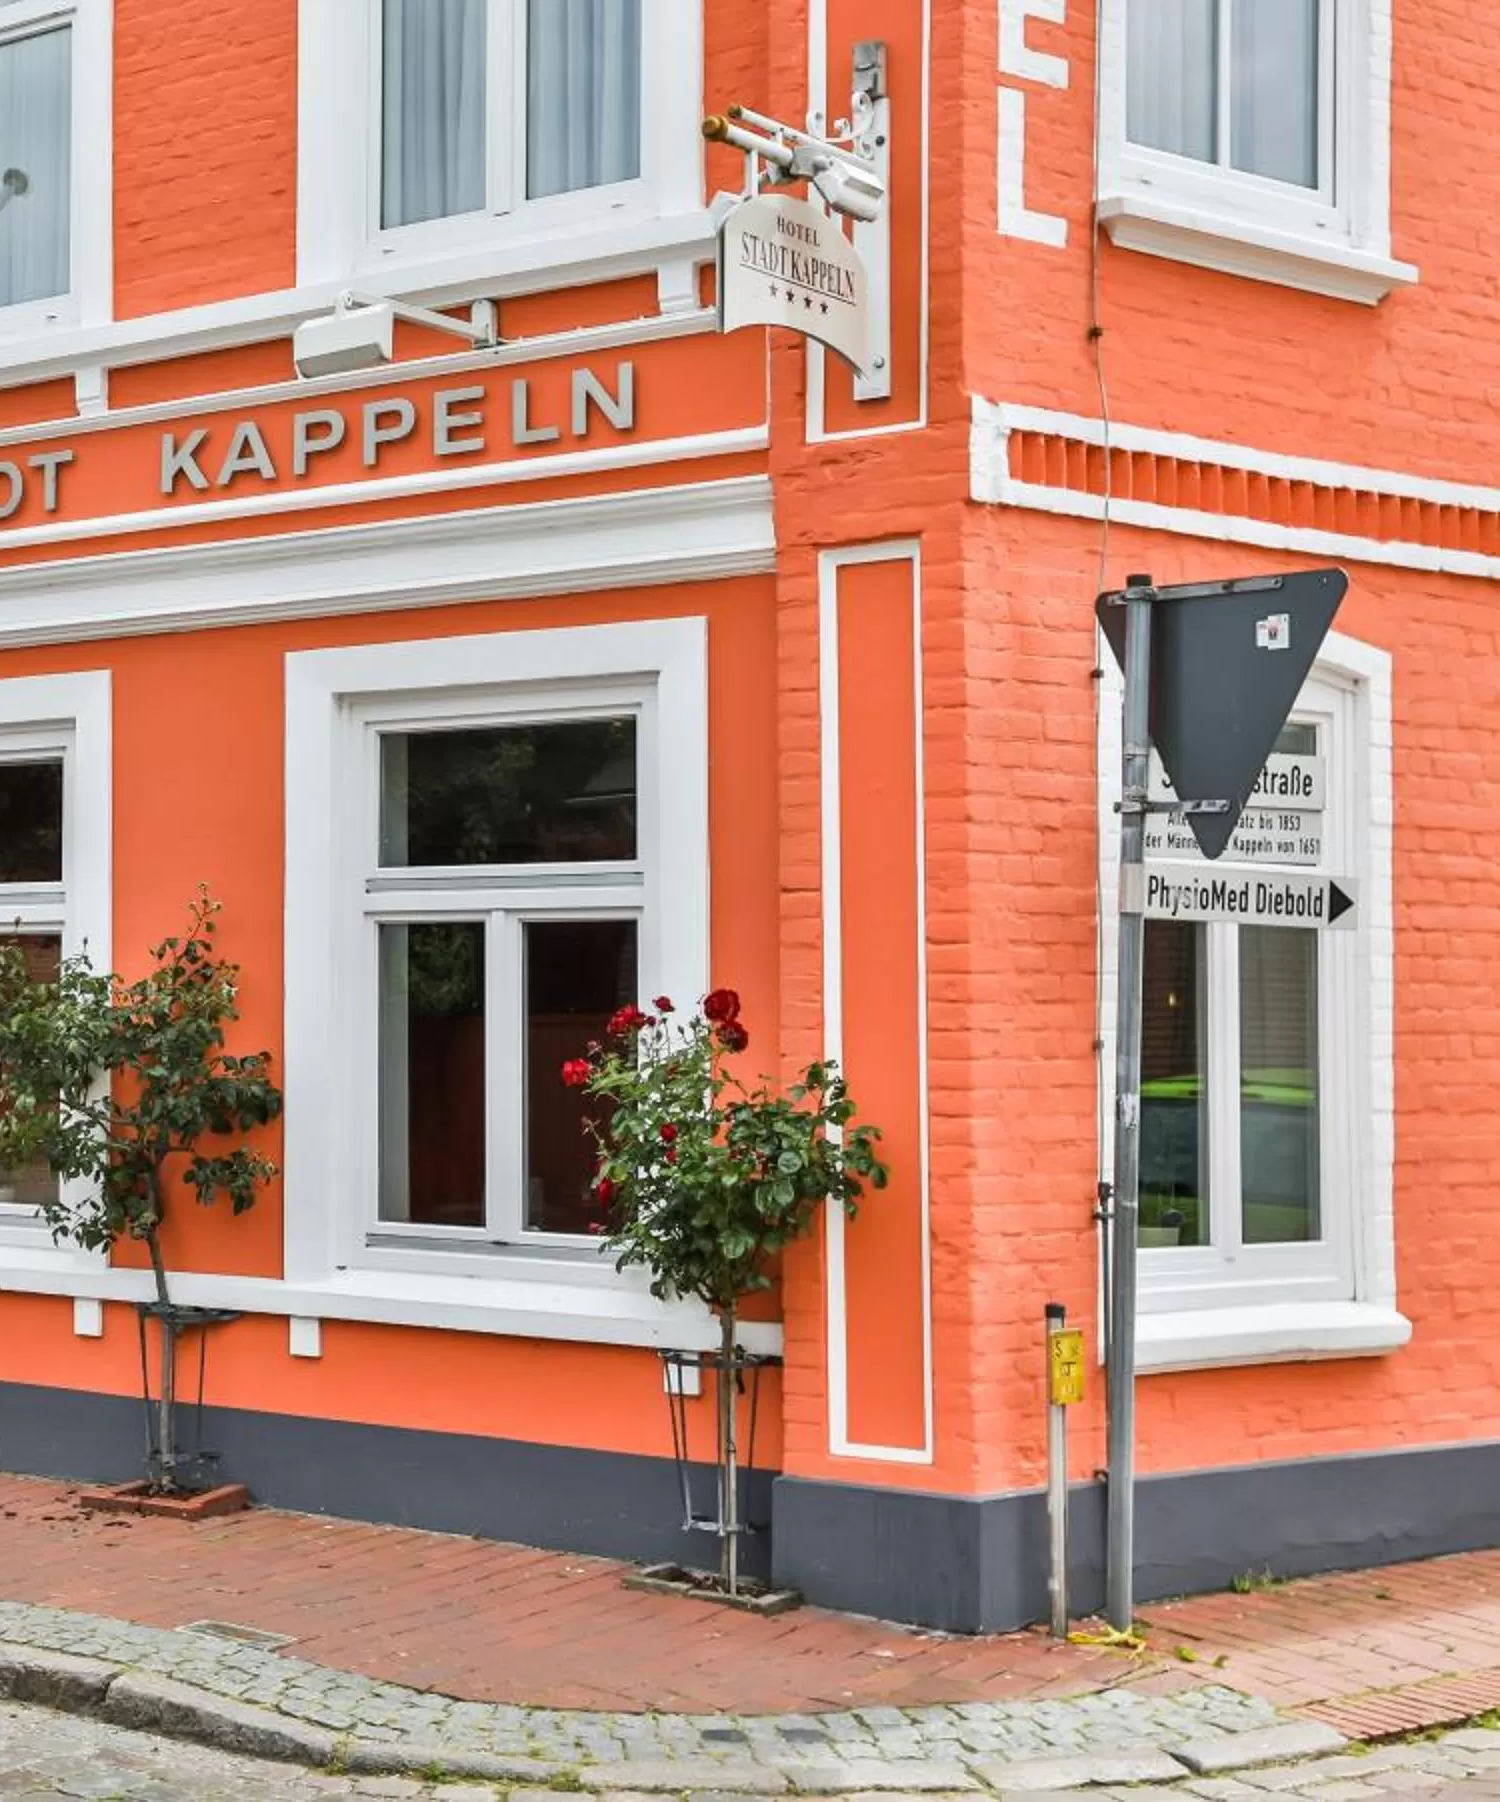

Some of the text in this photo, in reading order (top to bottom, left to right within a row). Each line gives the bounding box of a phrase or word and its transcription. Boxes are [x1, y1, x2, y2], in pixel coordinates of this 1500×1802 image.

[777, 216, 820, 246] HOTEL
[741, 231, 855, 298] STADT KAPPELN
[159, 360, 636, 495] KAPPELN
[1259, 812, 1273, 830] bis
[1279, 815, 1301, 831] 1853
[1145, 832, 1162, 849] der
[1233, 836, 1273, 855] Kappeln
[1277, 841, 1295, 853] von
[1299, 838, 1320, 855] 1651
[1147, 875, 1324, 917] PhysioMed Diebold
